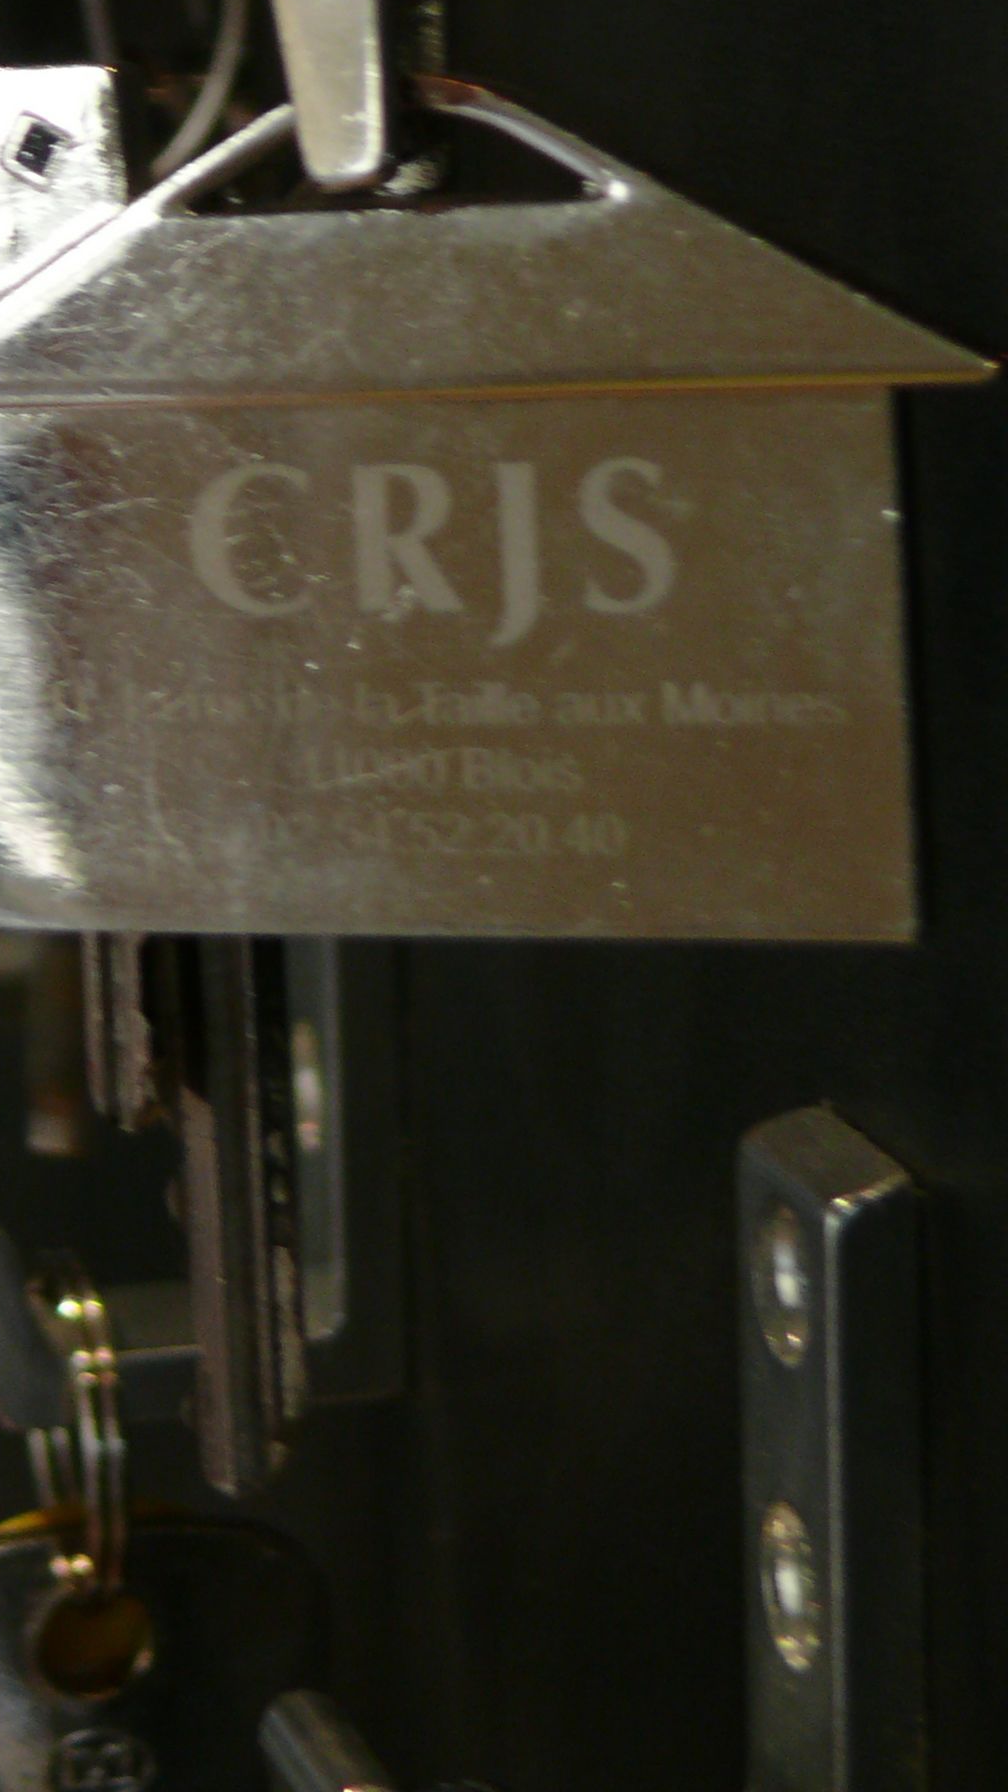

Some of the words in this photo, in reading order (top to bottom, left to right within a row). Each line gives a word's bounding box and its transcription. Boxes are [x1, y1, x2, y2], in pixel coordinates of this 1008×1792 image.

[190, 455, 678, 647] CRJS
[412, 680, 541, 726] Taille
[553, 690, 648, 726] aux
[657, 680, 847, 727] Moines
[461, 744, 587, 792] Blois
